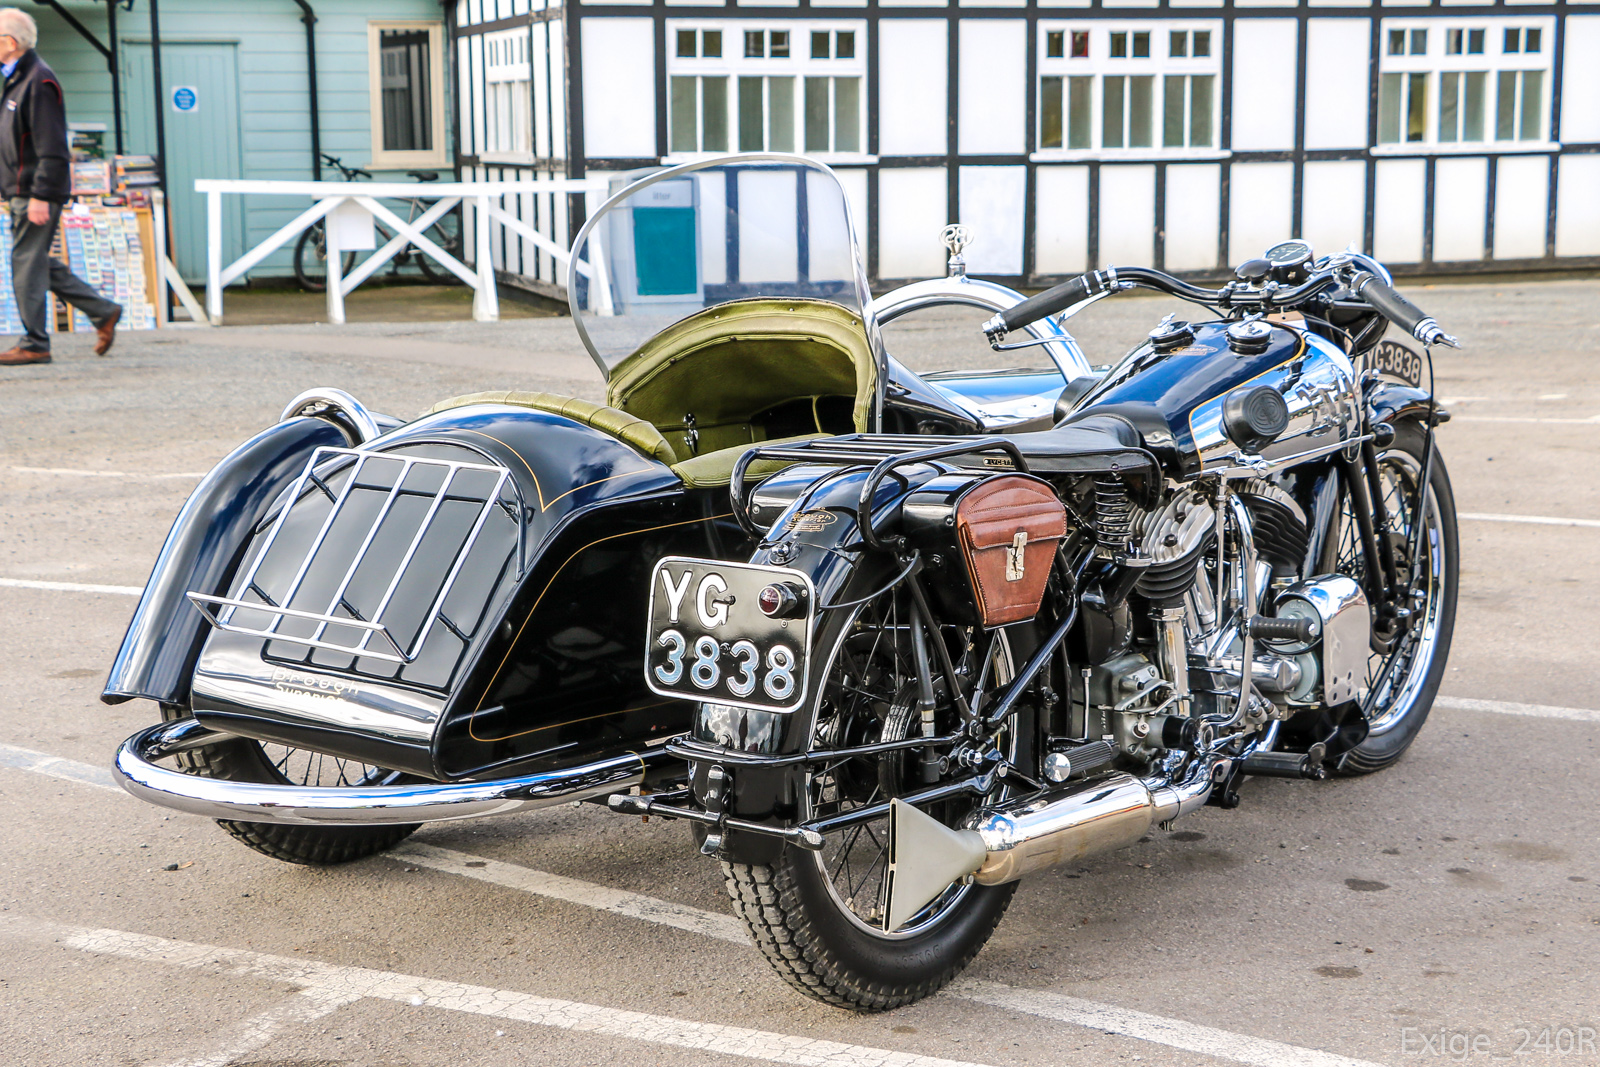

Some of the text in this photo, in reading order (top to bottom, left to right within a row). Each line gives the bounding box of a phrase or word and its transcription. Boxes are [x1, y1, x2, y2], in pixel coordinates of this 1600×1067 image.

[660, 568, 729, 630] YG
[271, 665, 361, 695] Brough
[654, 628, 796, 700] 3838
